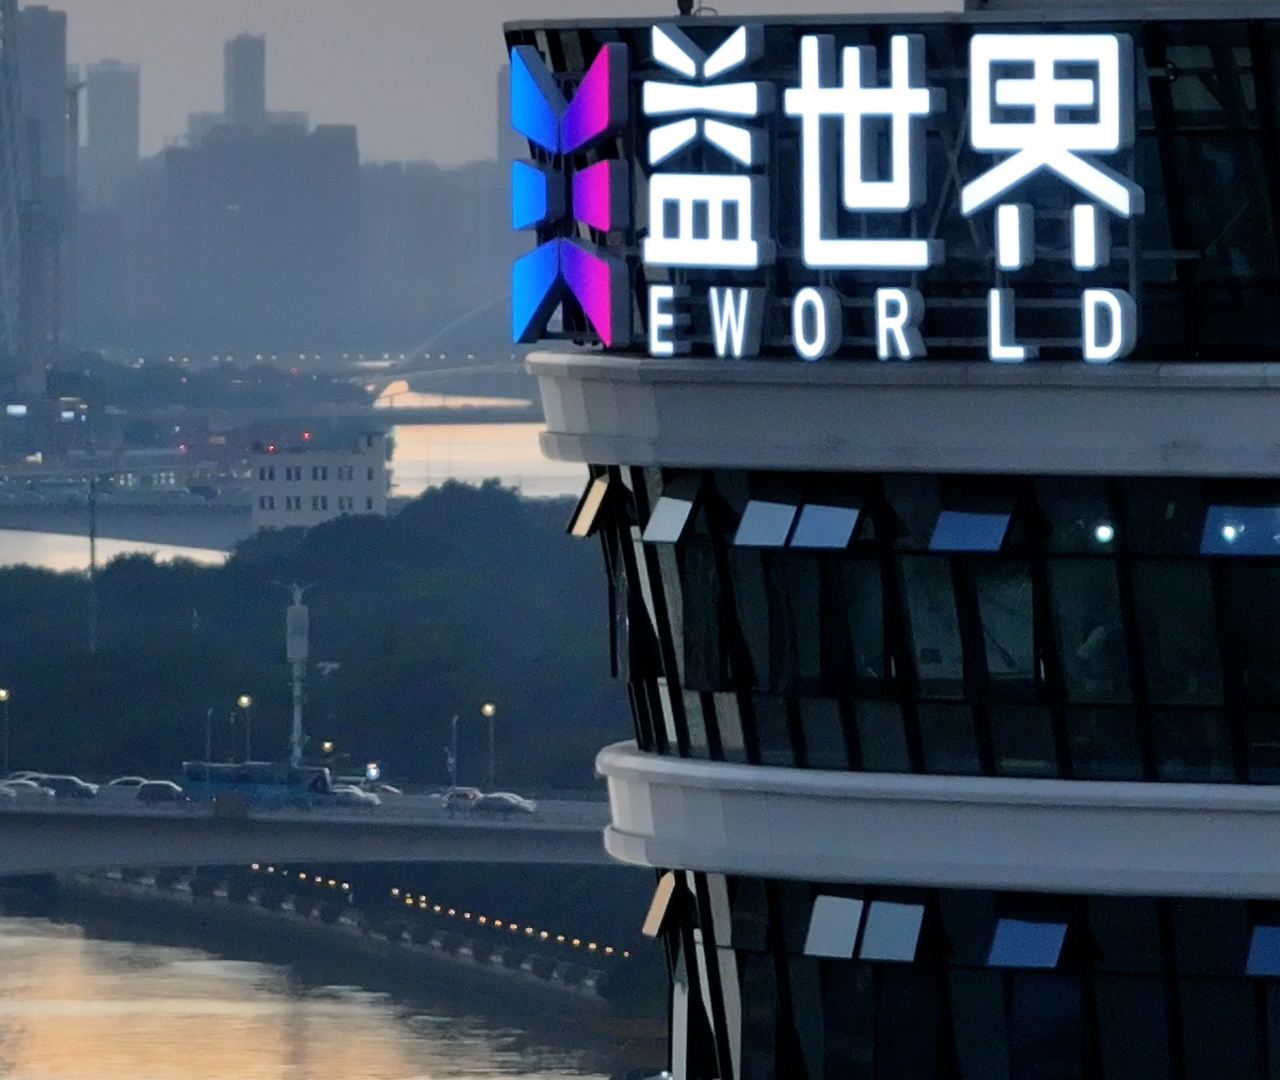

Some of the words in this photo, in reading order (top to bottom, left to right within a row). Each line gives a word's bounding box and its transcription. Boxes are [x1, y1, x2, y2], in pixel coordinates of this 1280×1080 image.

[644, 25, 1131, 268] 益世界
[649, 285, 1123, 360] EWORLD
